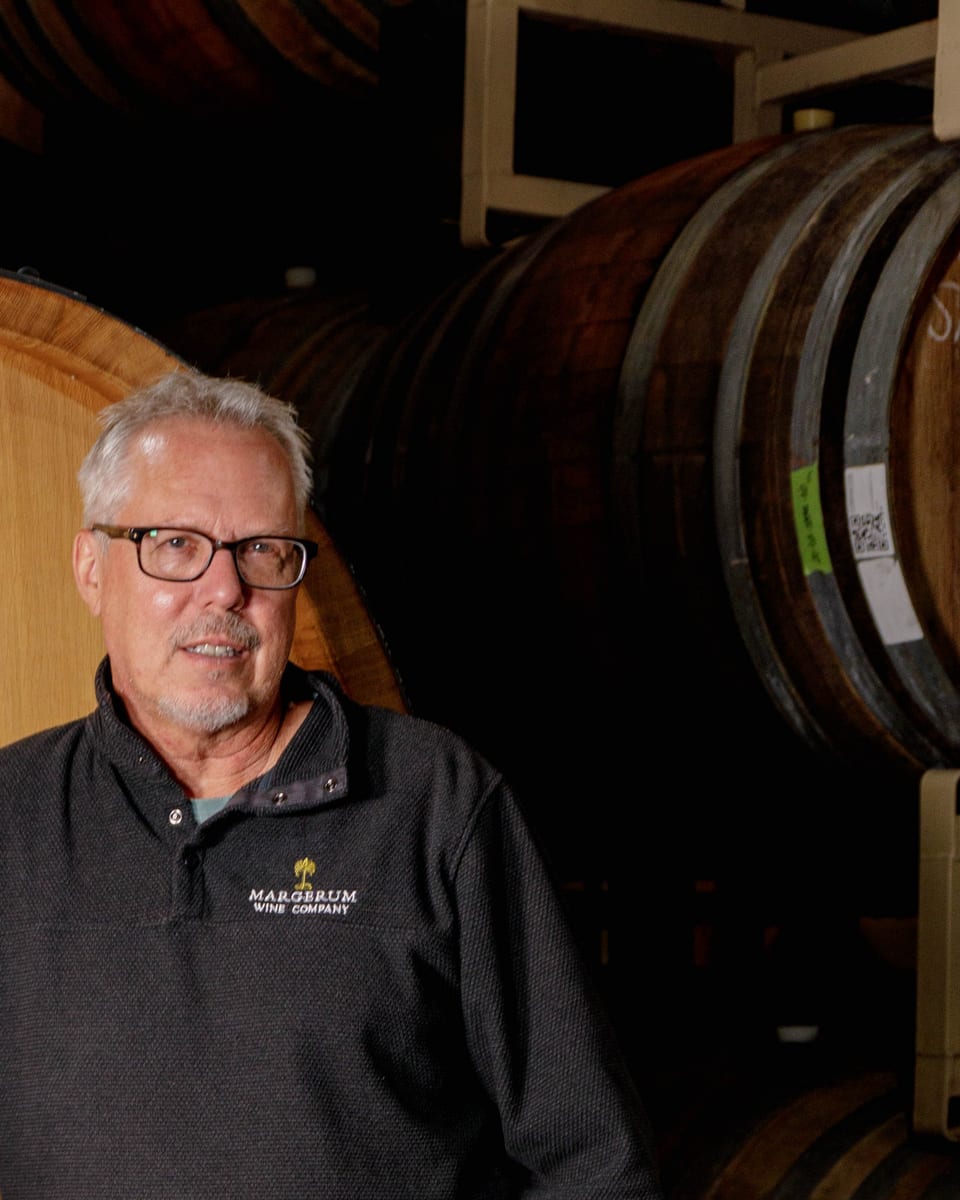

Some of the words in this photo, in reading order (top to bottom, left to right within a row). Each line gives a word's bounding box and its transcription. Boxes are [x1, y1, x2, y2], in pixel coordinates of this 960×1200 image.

[248, 888, 357, 904] MARGERUM
[253, 902, 286, 914] WINE
[291, 903, 350, 915] COMPANY
